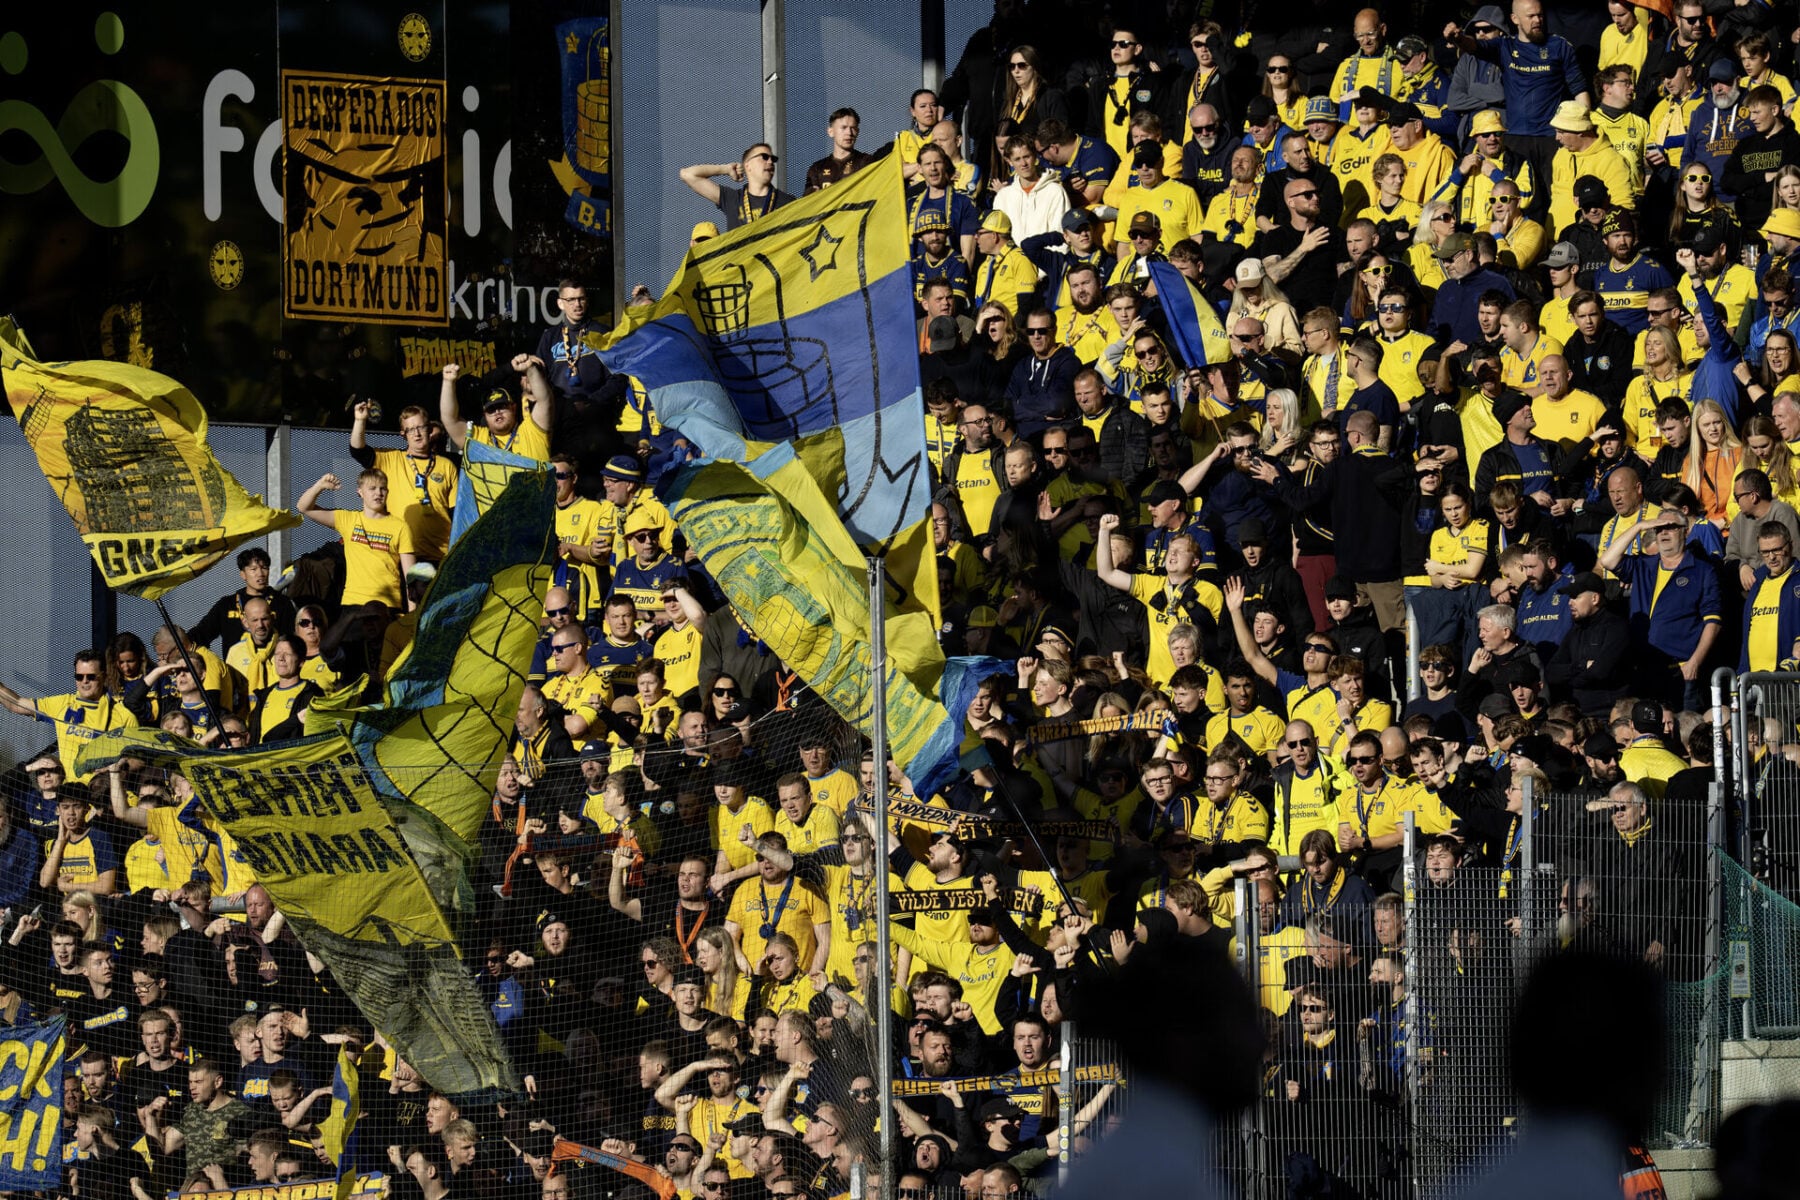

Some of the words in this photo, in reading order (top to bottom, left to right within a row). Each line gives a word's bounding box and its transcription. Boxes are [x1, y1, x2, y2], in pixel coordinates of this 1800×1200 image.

[291, 84, 438, 138] DESPERADOS
[293, 259, 441, 313] DORTMUND
[1602, 297, 1631, 307] etano
[1751, 605, 1780, 618] Betan
[896, 891, 942, 912] VILDE
